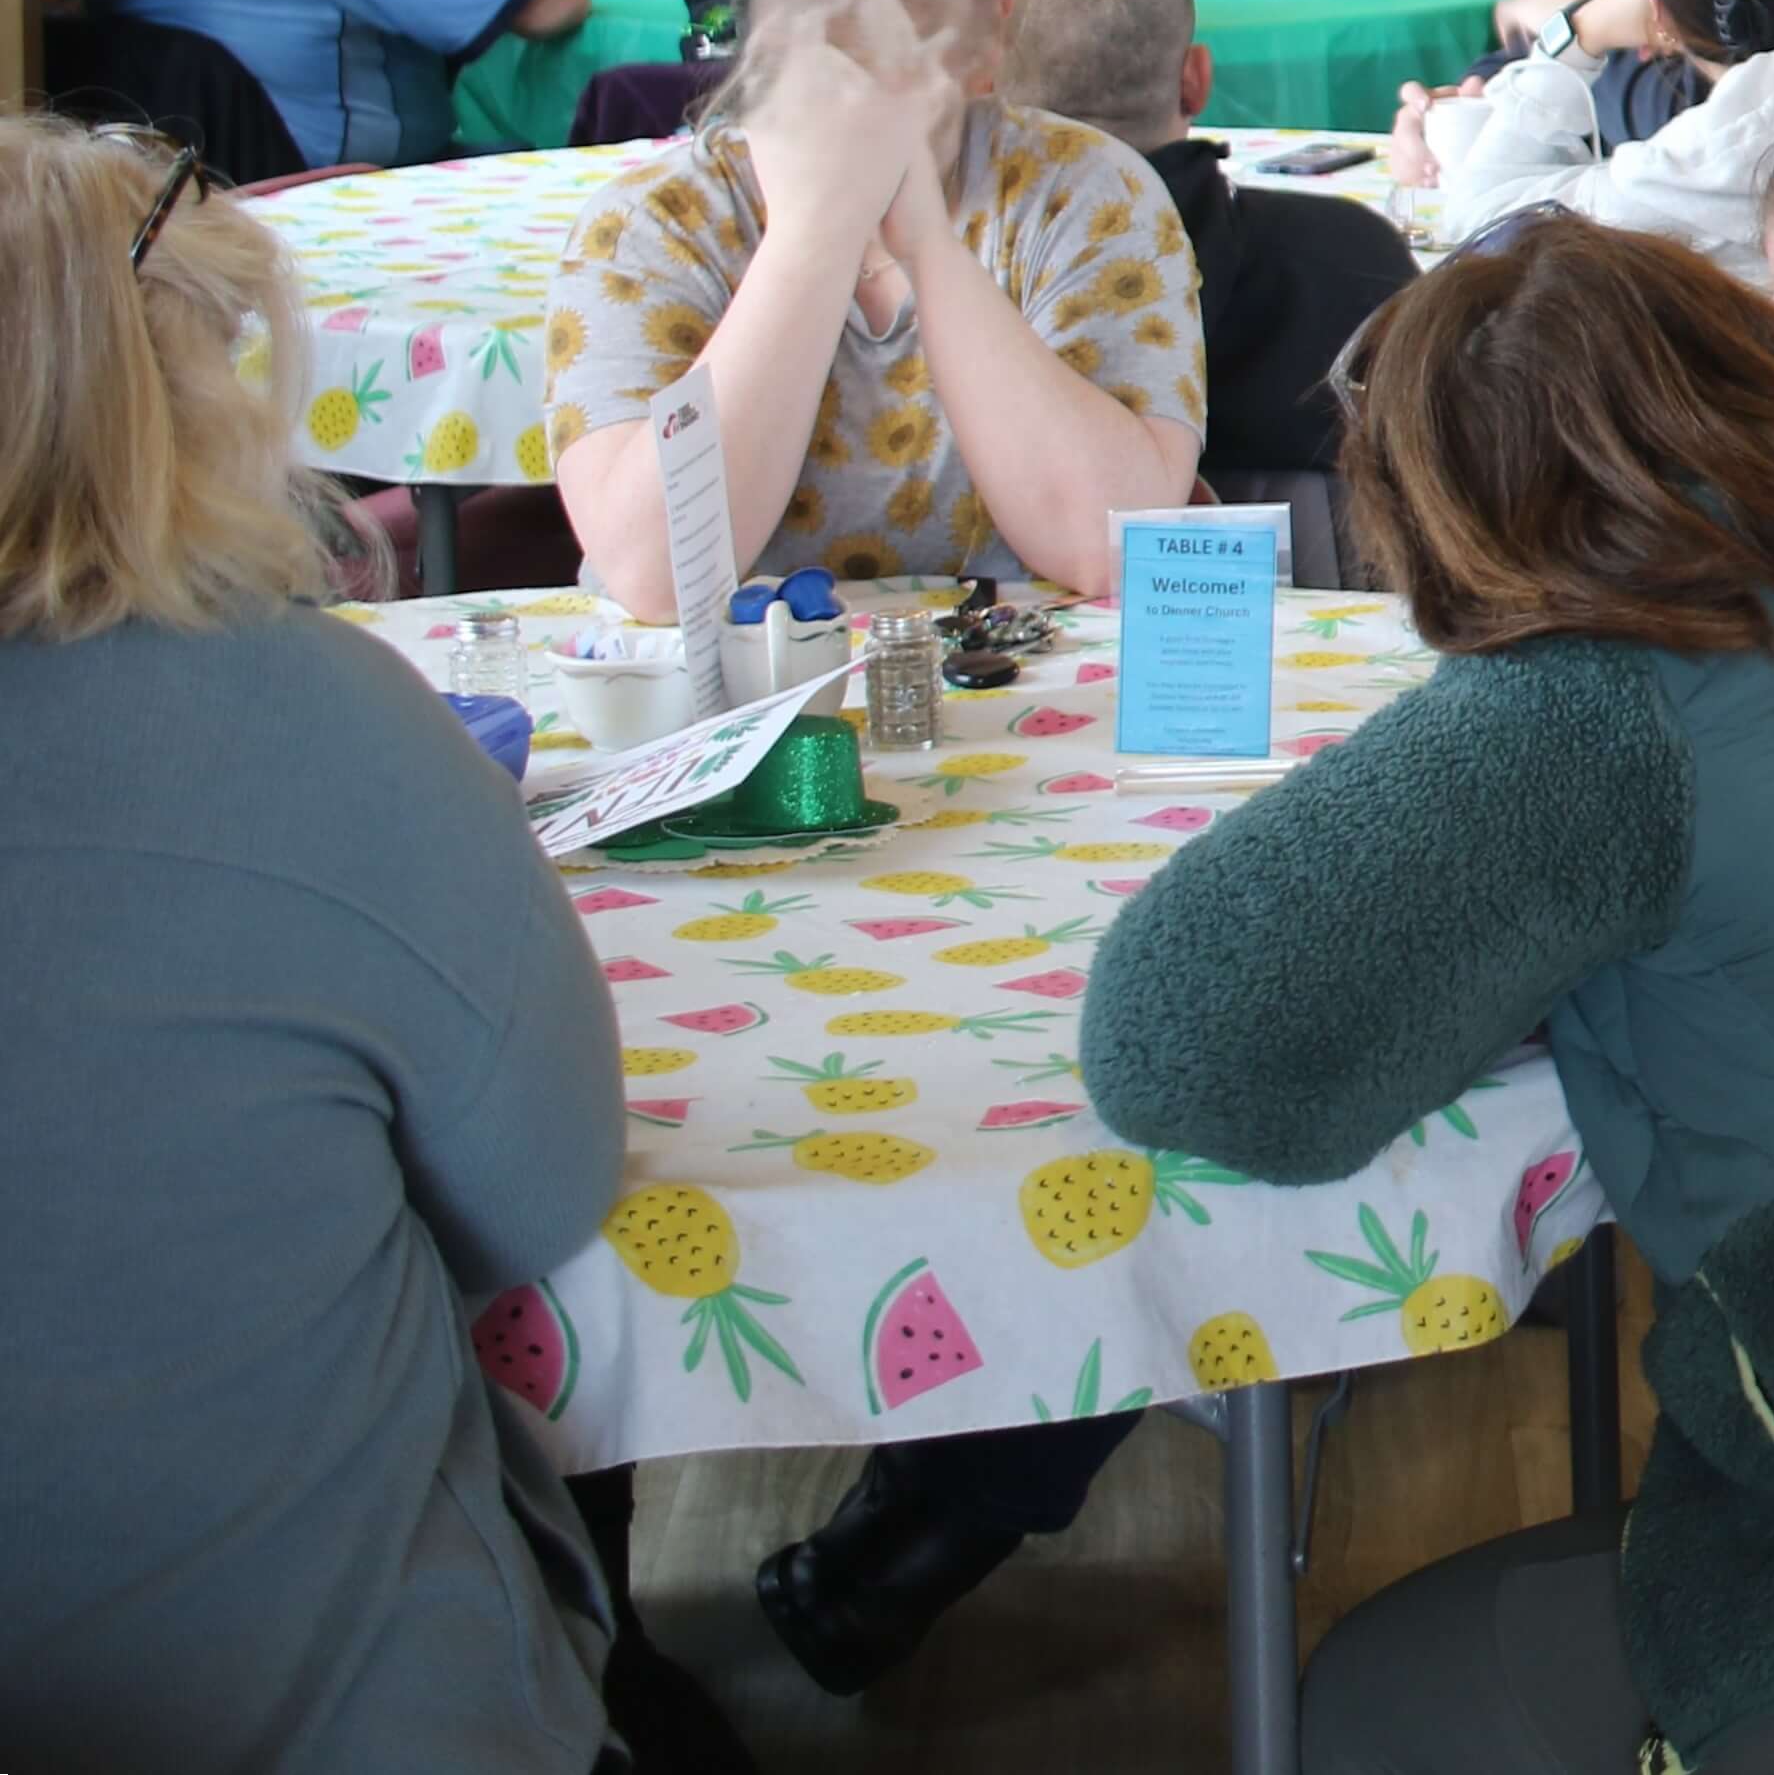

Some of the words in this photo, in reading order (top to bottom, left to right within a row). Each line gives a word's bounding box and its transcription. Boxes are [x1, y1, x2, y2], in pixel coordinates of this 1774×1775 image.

[1156, 537, 1213, 555] TABLE
[1217, 539, 1228, 555] #
[1231, 540, 1245, 556] 4
[1151, 576, 1247, 596] Welcome!
[1145, 605, 1159, 616] to
[1161, 605, 1202, 617] Dinner
[1205, 605, 1250, 618] Church
